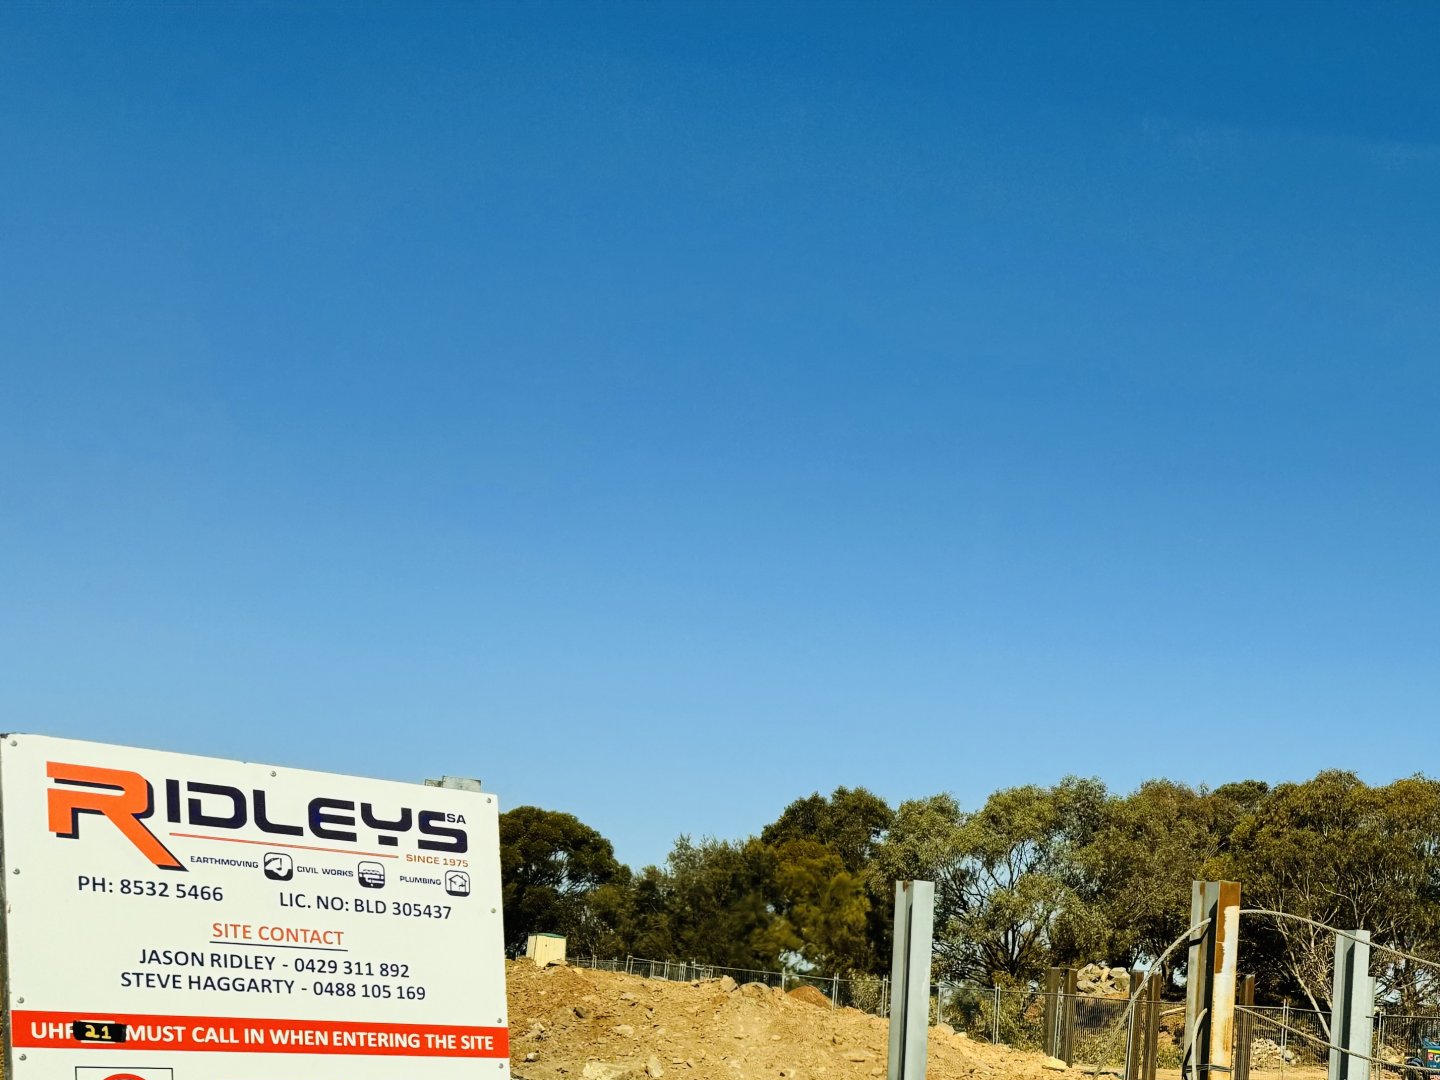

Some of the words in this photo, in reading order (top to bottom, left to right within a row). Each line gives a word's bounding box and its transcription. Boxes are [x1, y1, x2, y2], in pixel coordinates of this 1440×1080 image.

[46, 761, 468, 872] RIDLEYS
[446, 813, 467, 825] SA
[190, 855, 259, 869] EARTHMOVING
[296, 865, 319, 875] CIVIL
[321, 868, 354, 878] WORKS
[405, 854, 440, 865] SINCE
[442, 858, 469, 868] 1975
[78, 875, 114, 894] PH:
[120, 879, 170, 898] 8532
[175, 883, 224, 902] 5466
[399, 875, 442, 886] PLUMBING
[279, 892, 312, 909] LIC.
[316, 895, 349, 912] NO:
[354, 898, 387, 915] BLD
[392, 901, 452, 920] 305437
[212, 922, 252, 940] SITE
[258, 926, 345, 946] CONTACT
[139, 949, 205, 968] JASON
[210, 953, 276, 971] RIDLEY
[294, 958, 338, 974] 0429
[343, 961, 374, 976] 311
[379, 963, 410, 979] 892
[120, 971, 182, 990] STEVE
[188, 975, 295, 995] HAGGARTY
[313, 981, 356, 998] 0488
[361, 984, 391, 999] 105
[396, 986, 426, 1001] 169
[85, 1024, 112, 1040] 21
[125, 1024, 187, 1043] MUST
[191, 1026, 240, 1044] CALL
[244, 1028, 265, 1045] IN
[269, 1028, 329, 1047] WHEN
[333, 1031, 421, 1049] ENTERING
[424, 1033, 457, 1050] THE
[460, 1035, 494, 1051] SITE
